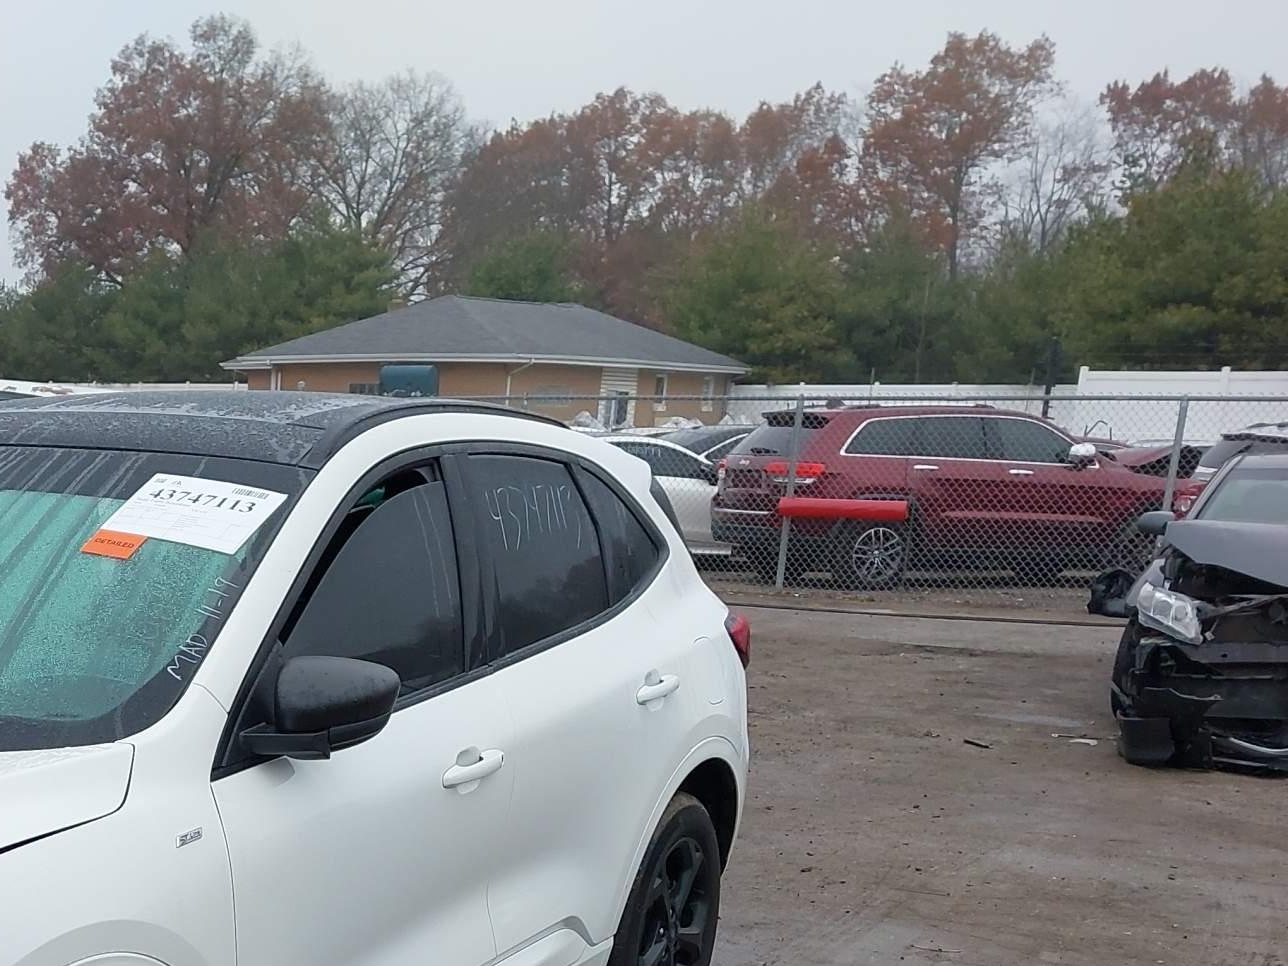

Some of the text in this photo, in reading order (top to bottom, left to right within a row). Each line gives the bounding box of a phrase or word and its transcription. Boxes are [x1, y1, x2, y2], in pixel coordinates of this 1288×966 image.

[149, 487, 257, 514] 43747113
[94, 537, 135, 548] DETAILED
[167, 576, 240, 680] MAD 11-19
